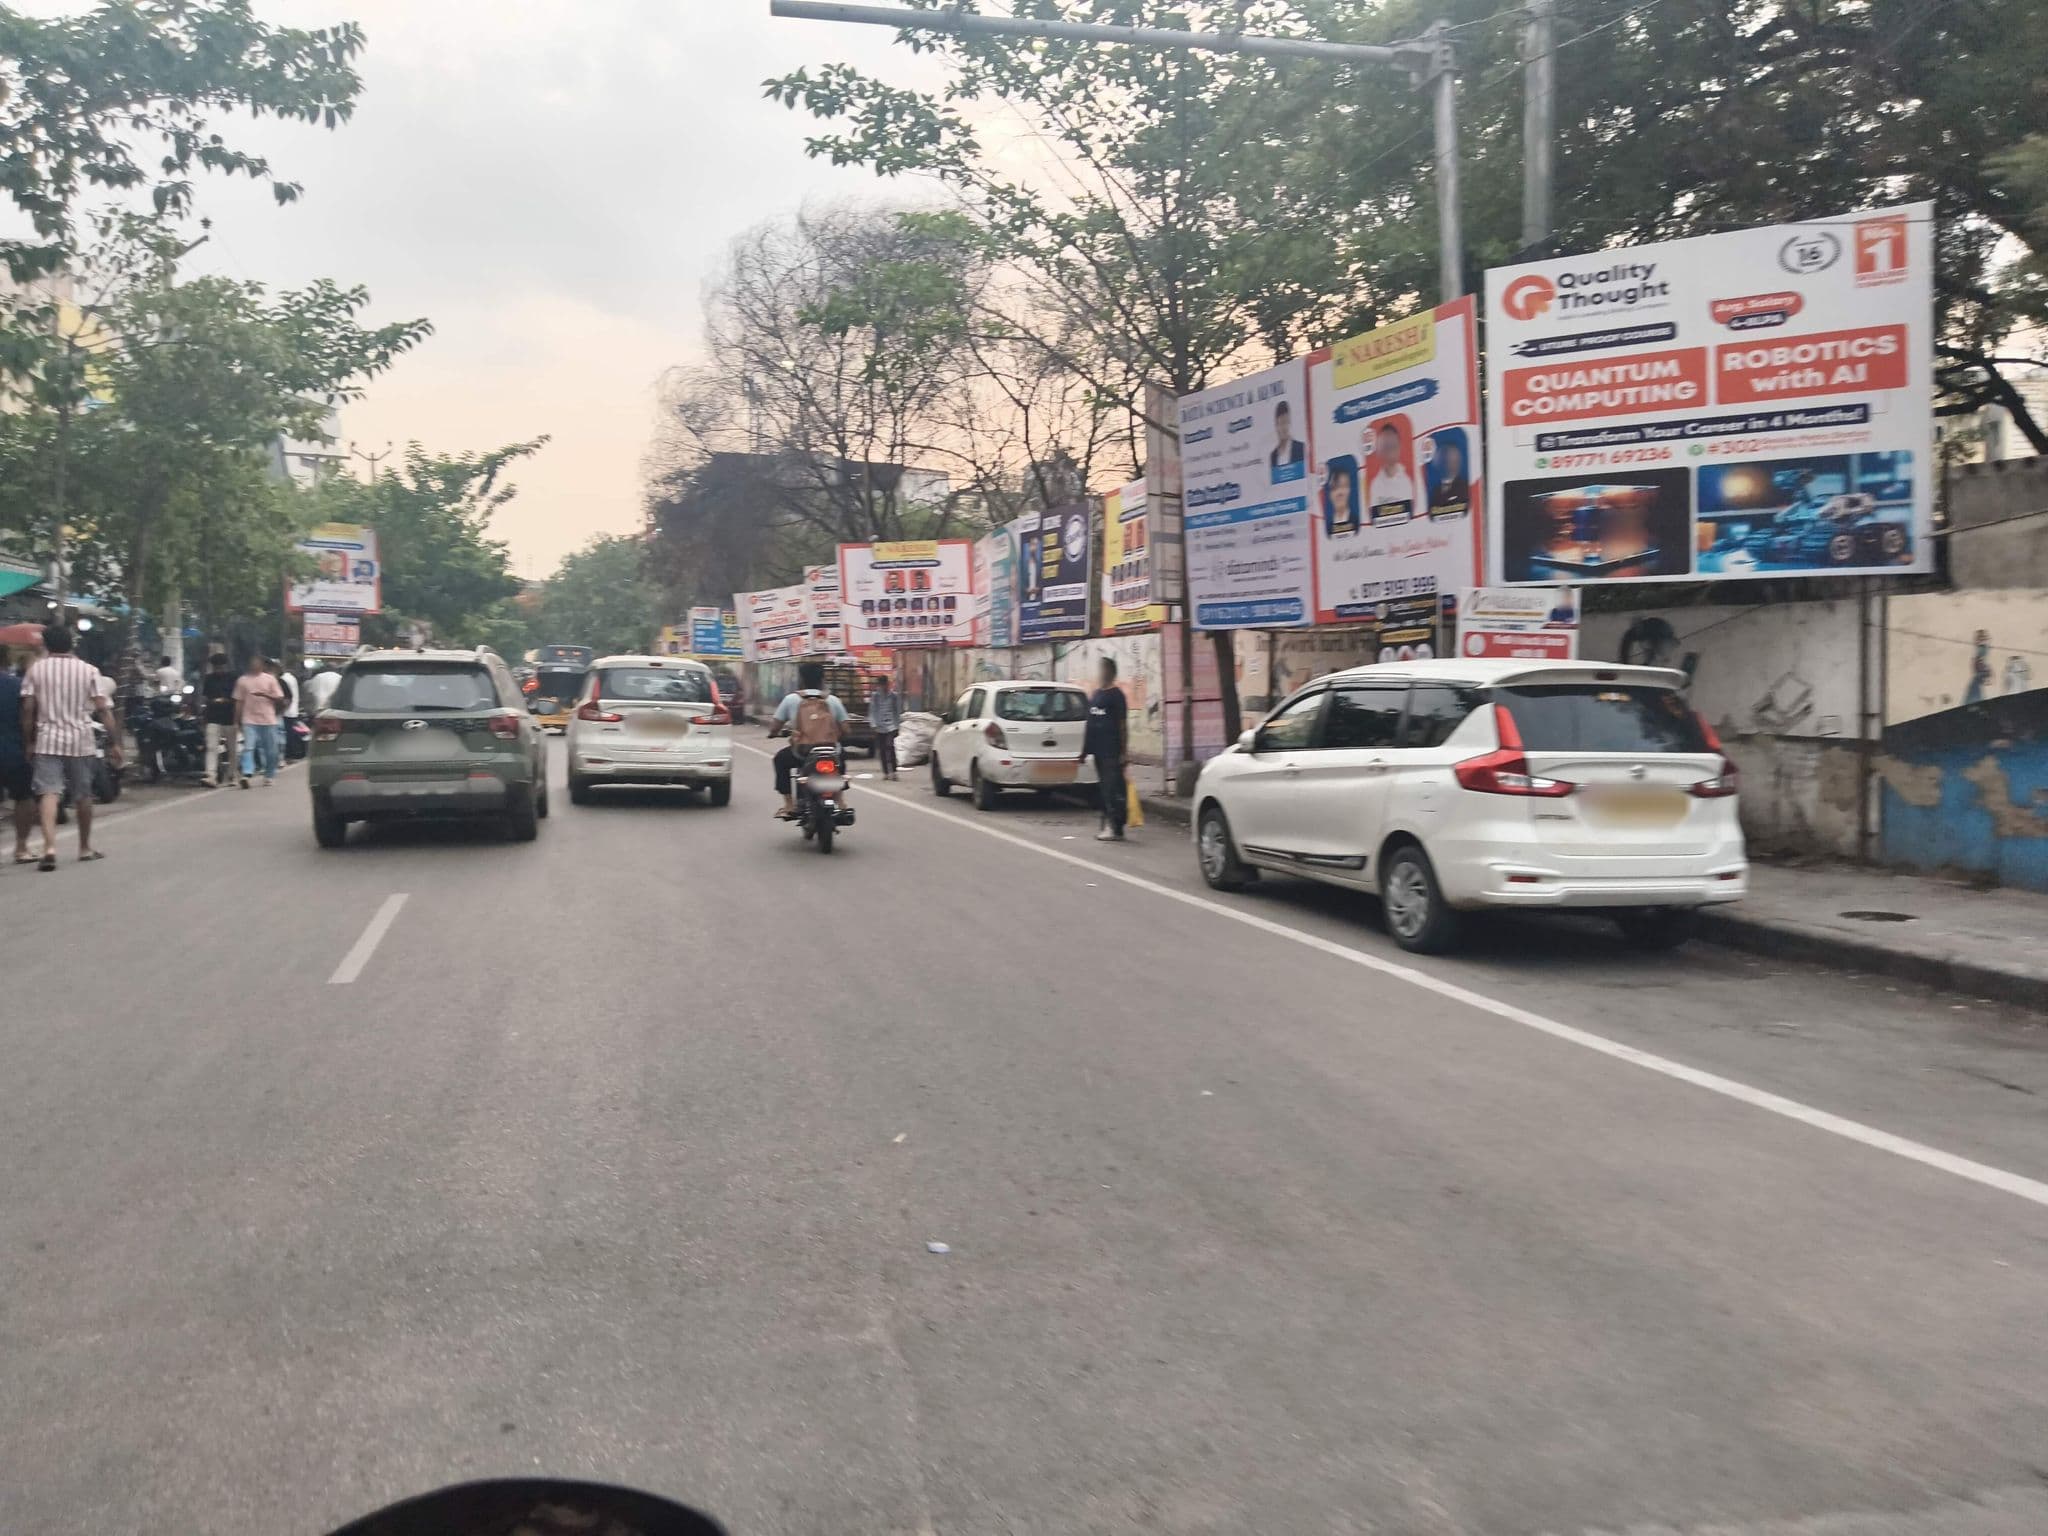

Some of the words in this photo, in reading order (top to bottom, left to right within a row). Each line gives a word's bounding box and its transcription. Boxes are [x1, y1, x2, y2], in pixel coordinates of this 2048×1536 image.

[1863, 239, 1891, 273] 1
[1558, 263, 1656, 289] Quality
[1558, 281, 1669, 309] Thought
[1723, 334, 1899, 371] ROBOTICS
[1526, 358, 1682, 393] QUANTUM
[1751, 369, 1825, 392] with
[1830, 363, 1869, 384] AI
[1511, 380, 1698, 417] COMPUTING
[1642, 425, 1682, 440] Your
[1685, 420, 1746, 436] Career
